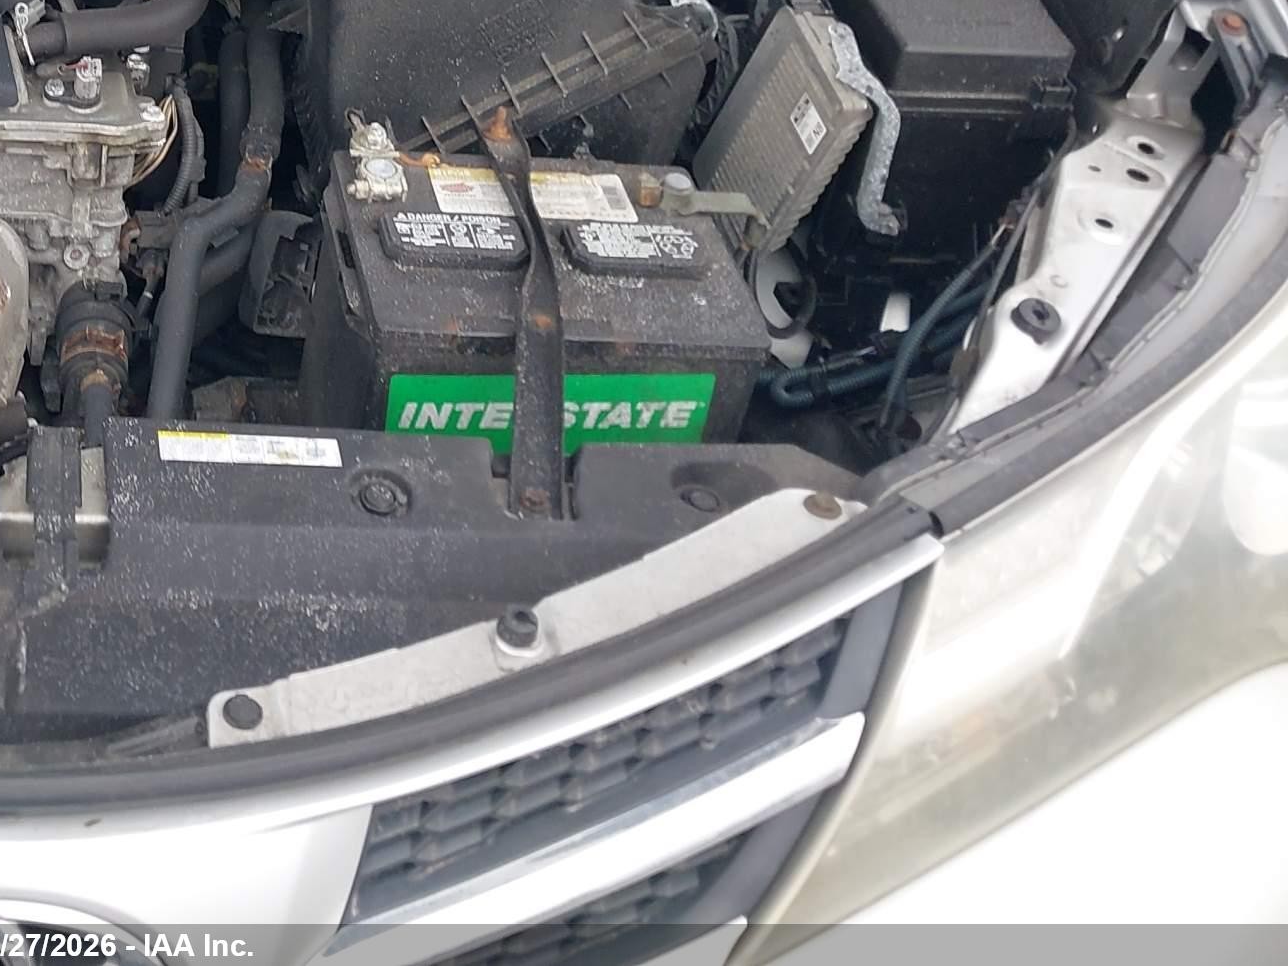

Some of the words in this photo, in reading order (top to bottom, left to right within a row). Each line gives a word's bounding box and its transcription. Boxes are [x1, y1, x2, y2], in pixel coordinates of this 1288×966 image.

[407, 212, 452, 222] DANGER
[461, 214, 501, 224] POISON
[398, 401, 698, 430] INTESTATE
